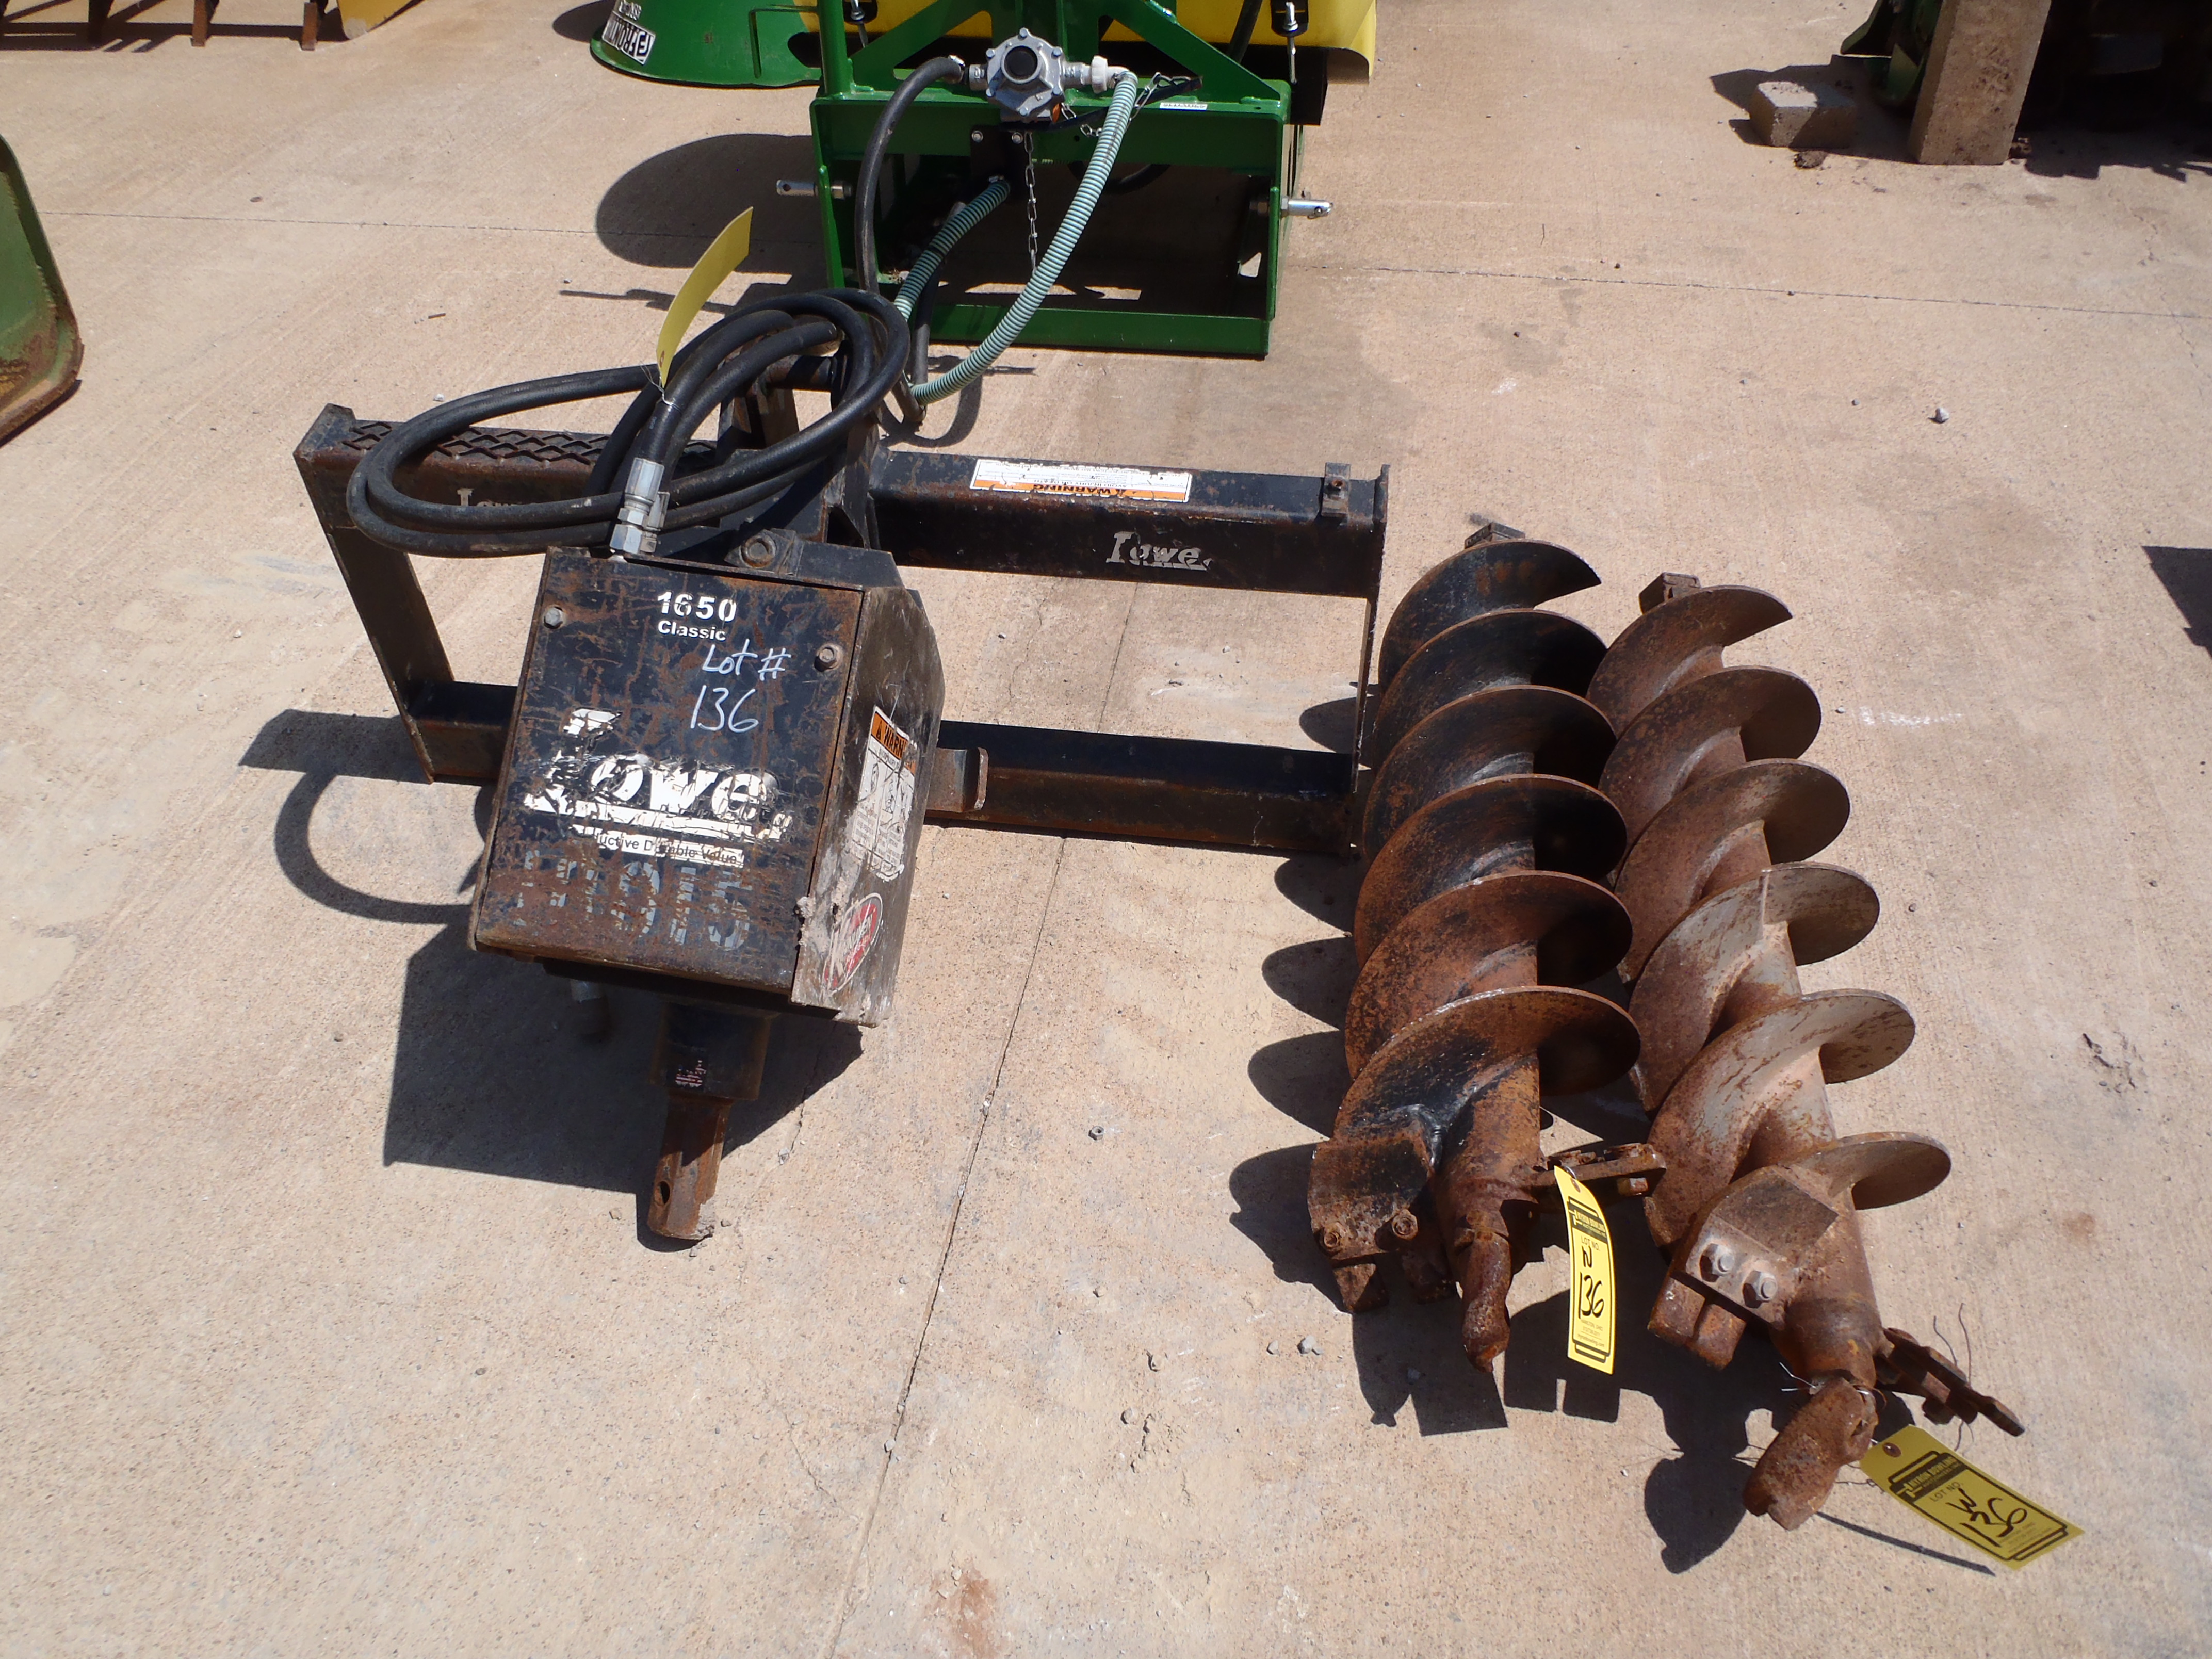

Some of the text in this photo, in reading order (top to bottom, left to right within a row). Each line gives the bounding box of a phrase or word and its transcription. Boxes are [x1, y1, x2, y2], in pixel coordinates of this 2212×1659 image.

[1033, 484, 1111, 495] WARNING
[657, 591, 737, 622] 1650
[657, 620, 726, 641] Classic
[702, 639, 792, 681] Lot #
[690, 685, 759, 733] 136
[1581, 1235, 1601, 1251] LOT NO.
[1578, 1272, 1604, 1320] 136
[1929, 1481, 1964, 1502] LOT NO.
